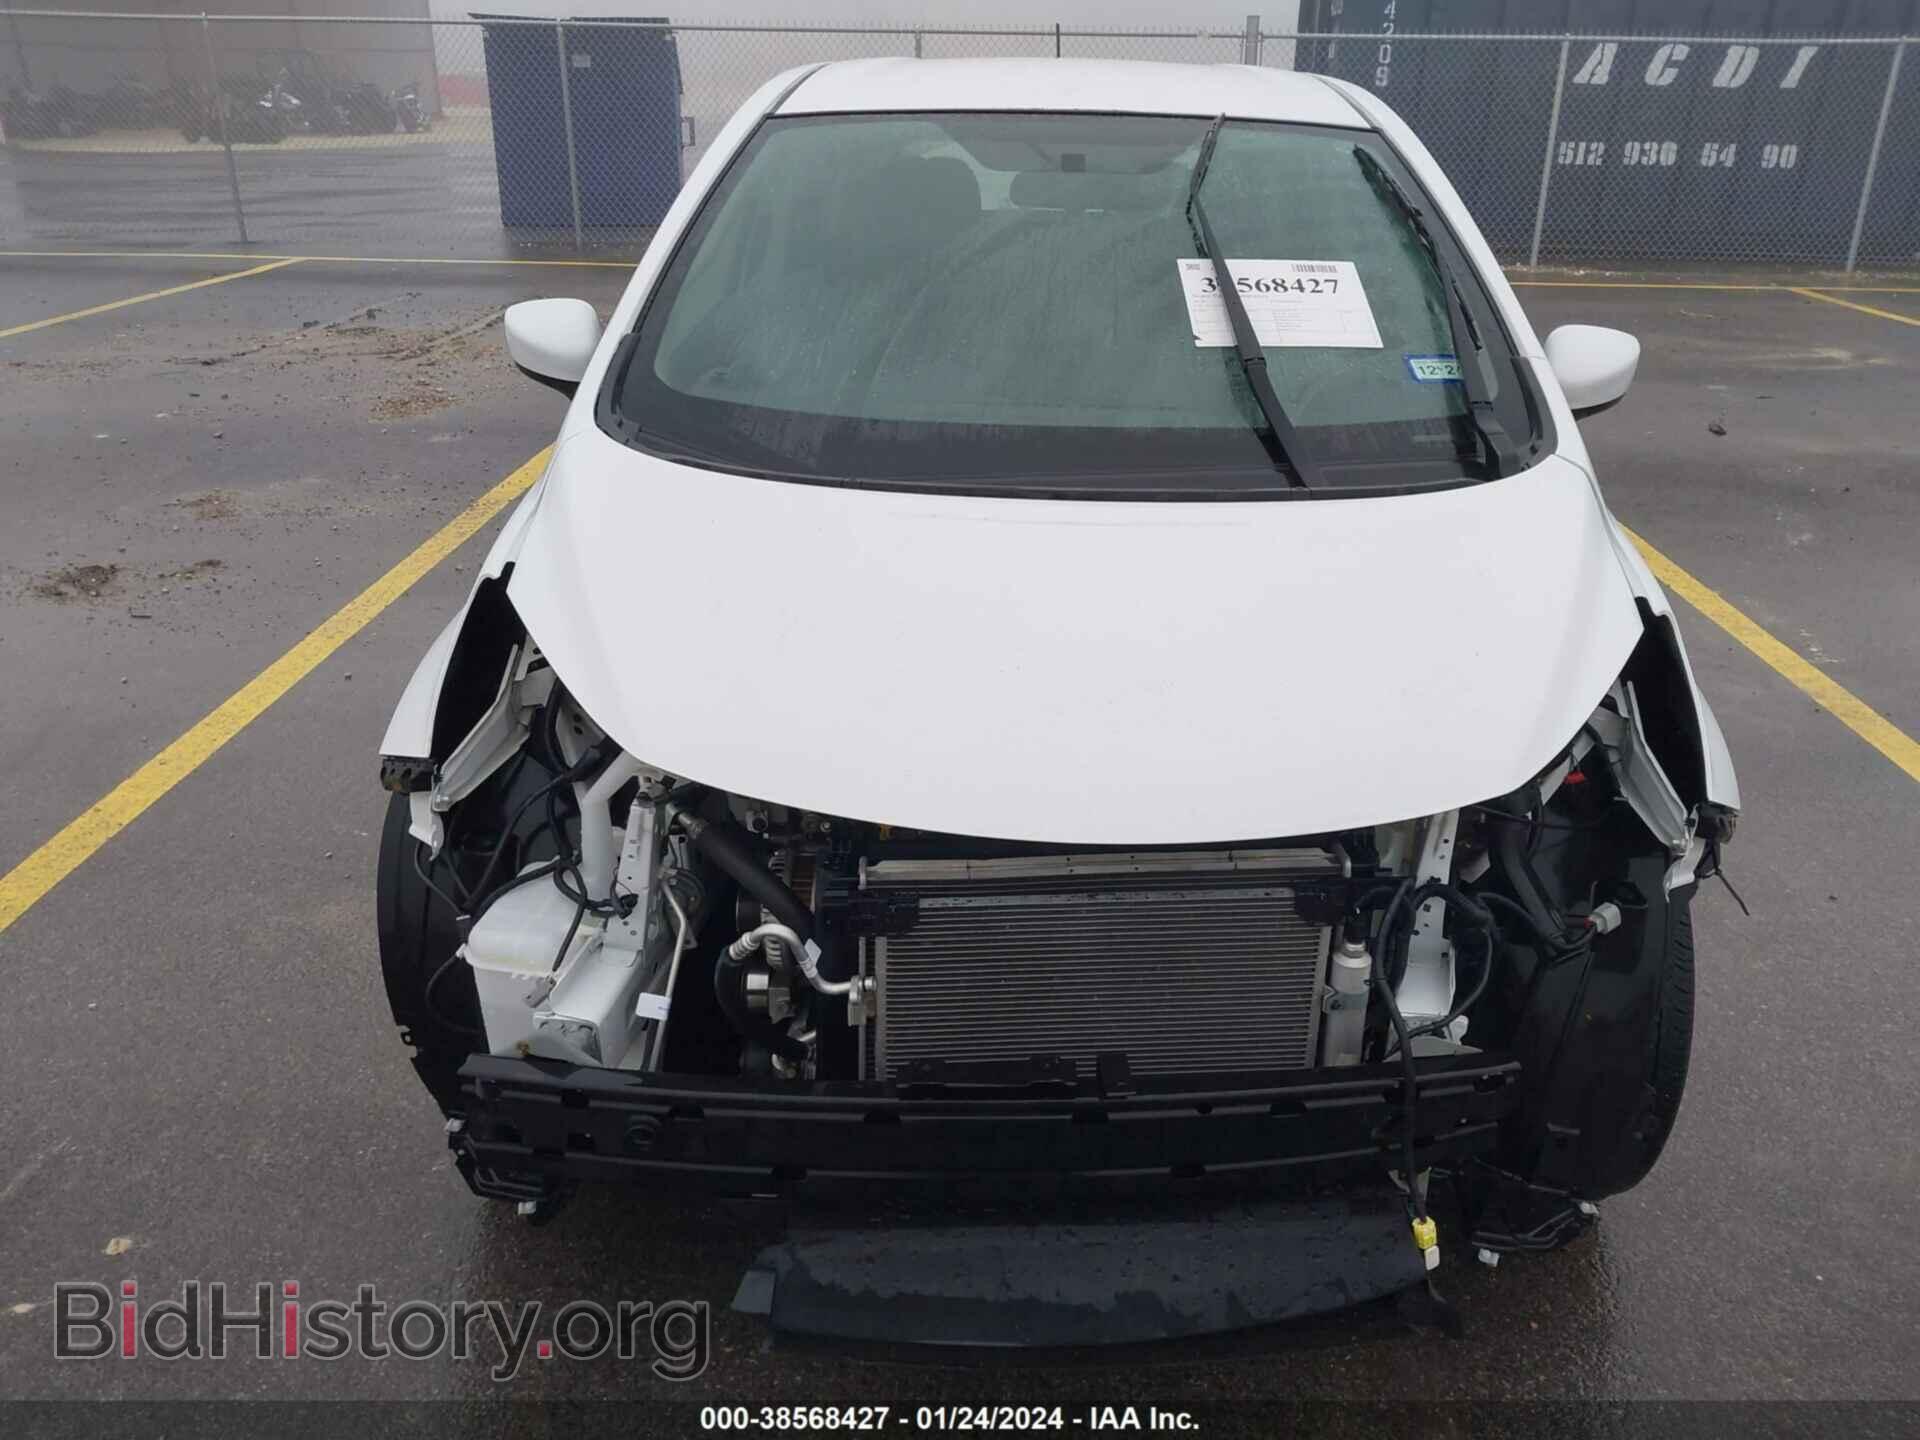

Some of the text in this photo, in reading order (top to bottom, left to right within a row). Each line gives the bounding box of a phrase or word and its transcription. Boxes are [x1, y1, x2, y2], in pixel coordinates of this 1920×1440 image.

[1557, 141, 1606, 166] 512
[1760, 143, 1798, 169] 90
[1201, 277, 1338, 295] 3568427
